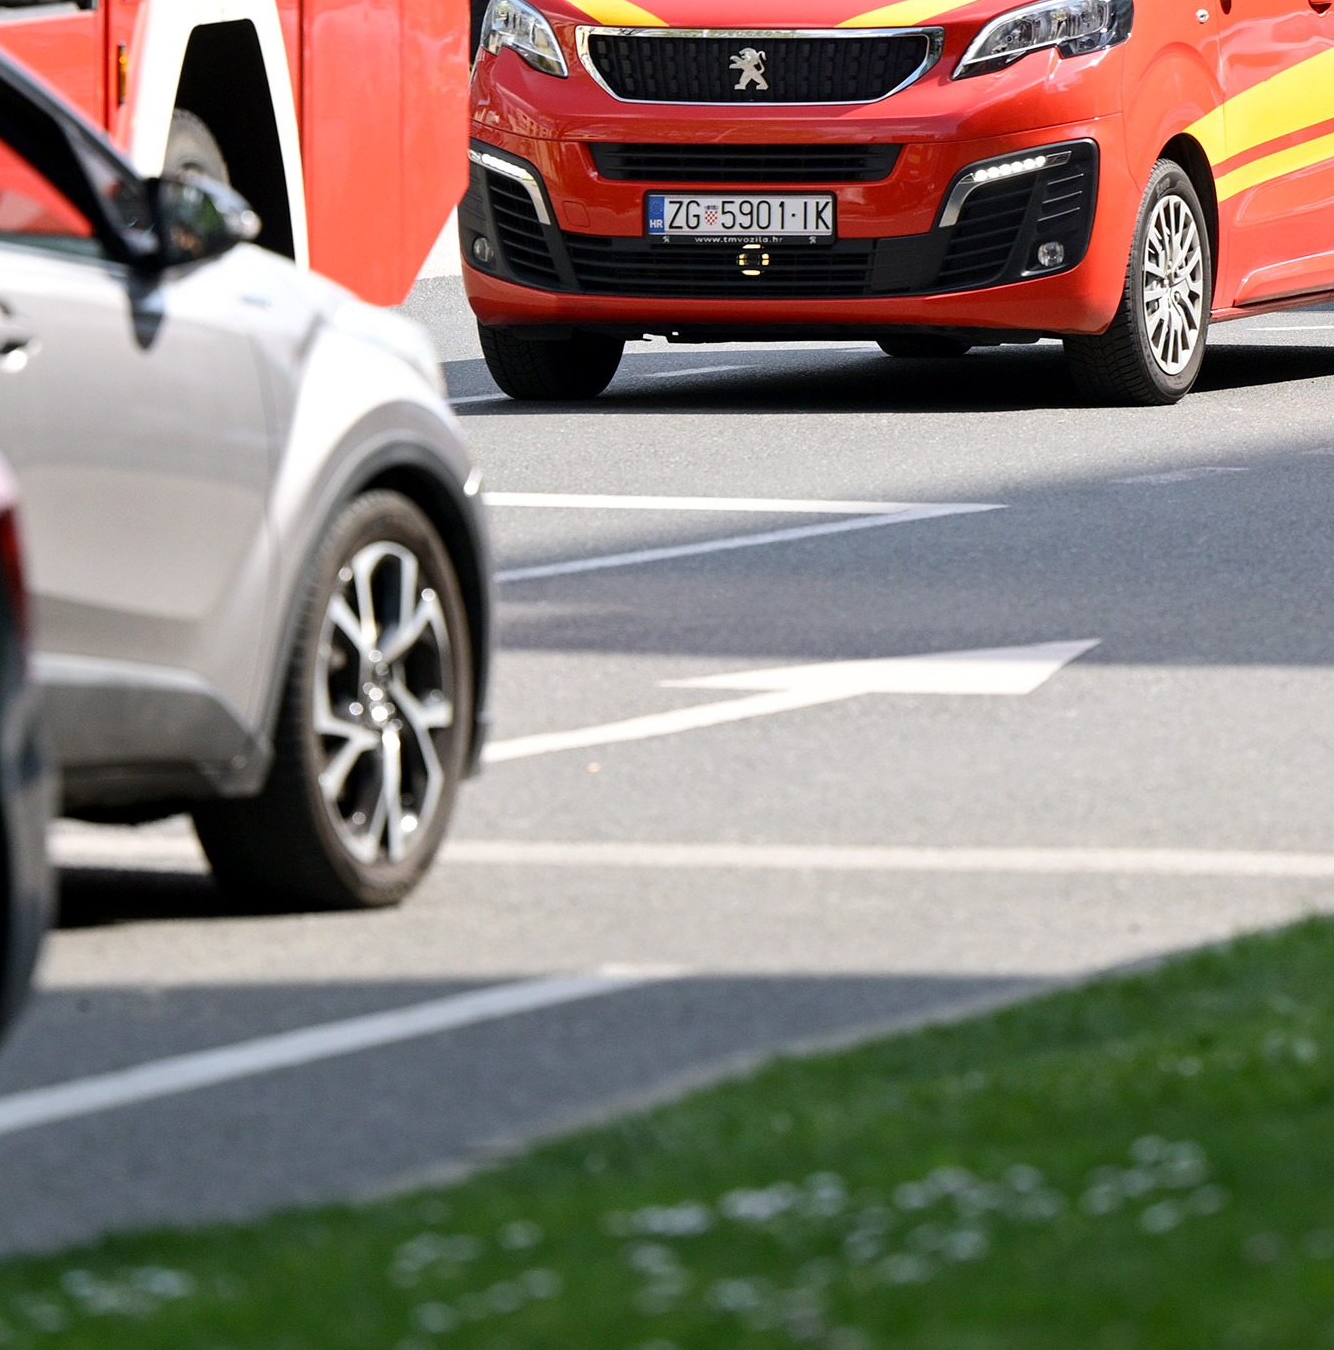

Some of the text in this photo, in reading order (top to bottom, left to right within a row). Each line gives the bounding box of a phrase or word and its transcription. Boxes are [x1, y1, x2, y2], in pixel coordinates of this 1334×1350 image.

[668, 200, 701, 230] ZG
[649, 219, 664, 229] HR
[695, 235, 784, 244] www.tmvozila.hr
